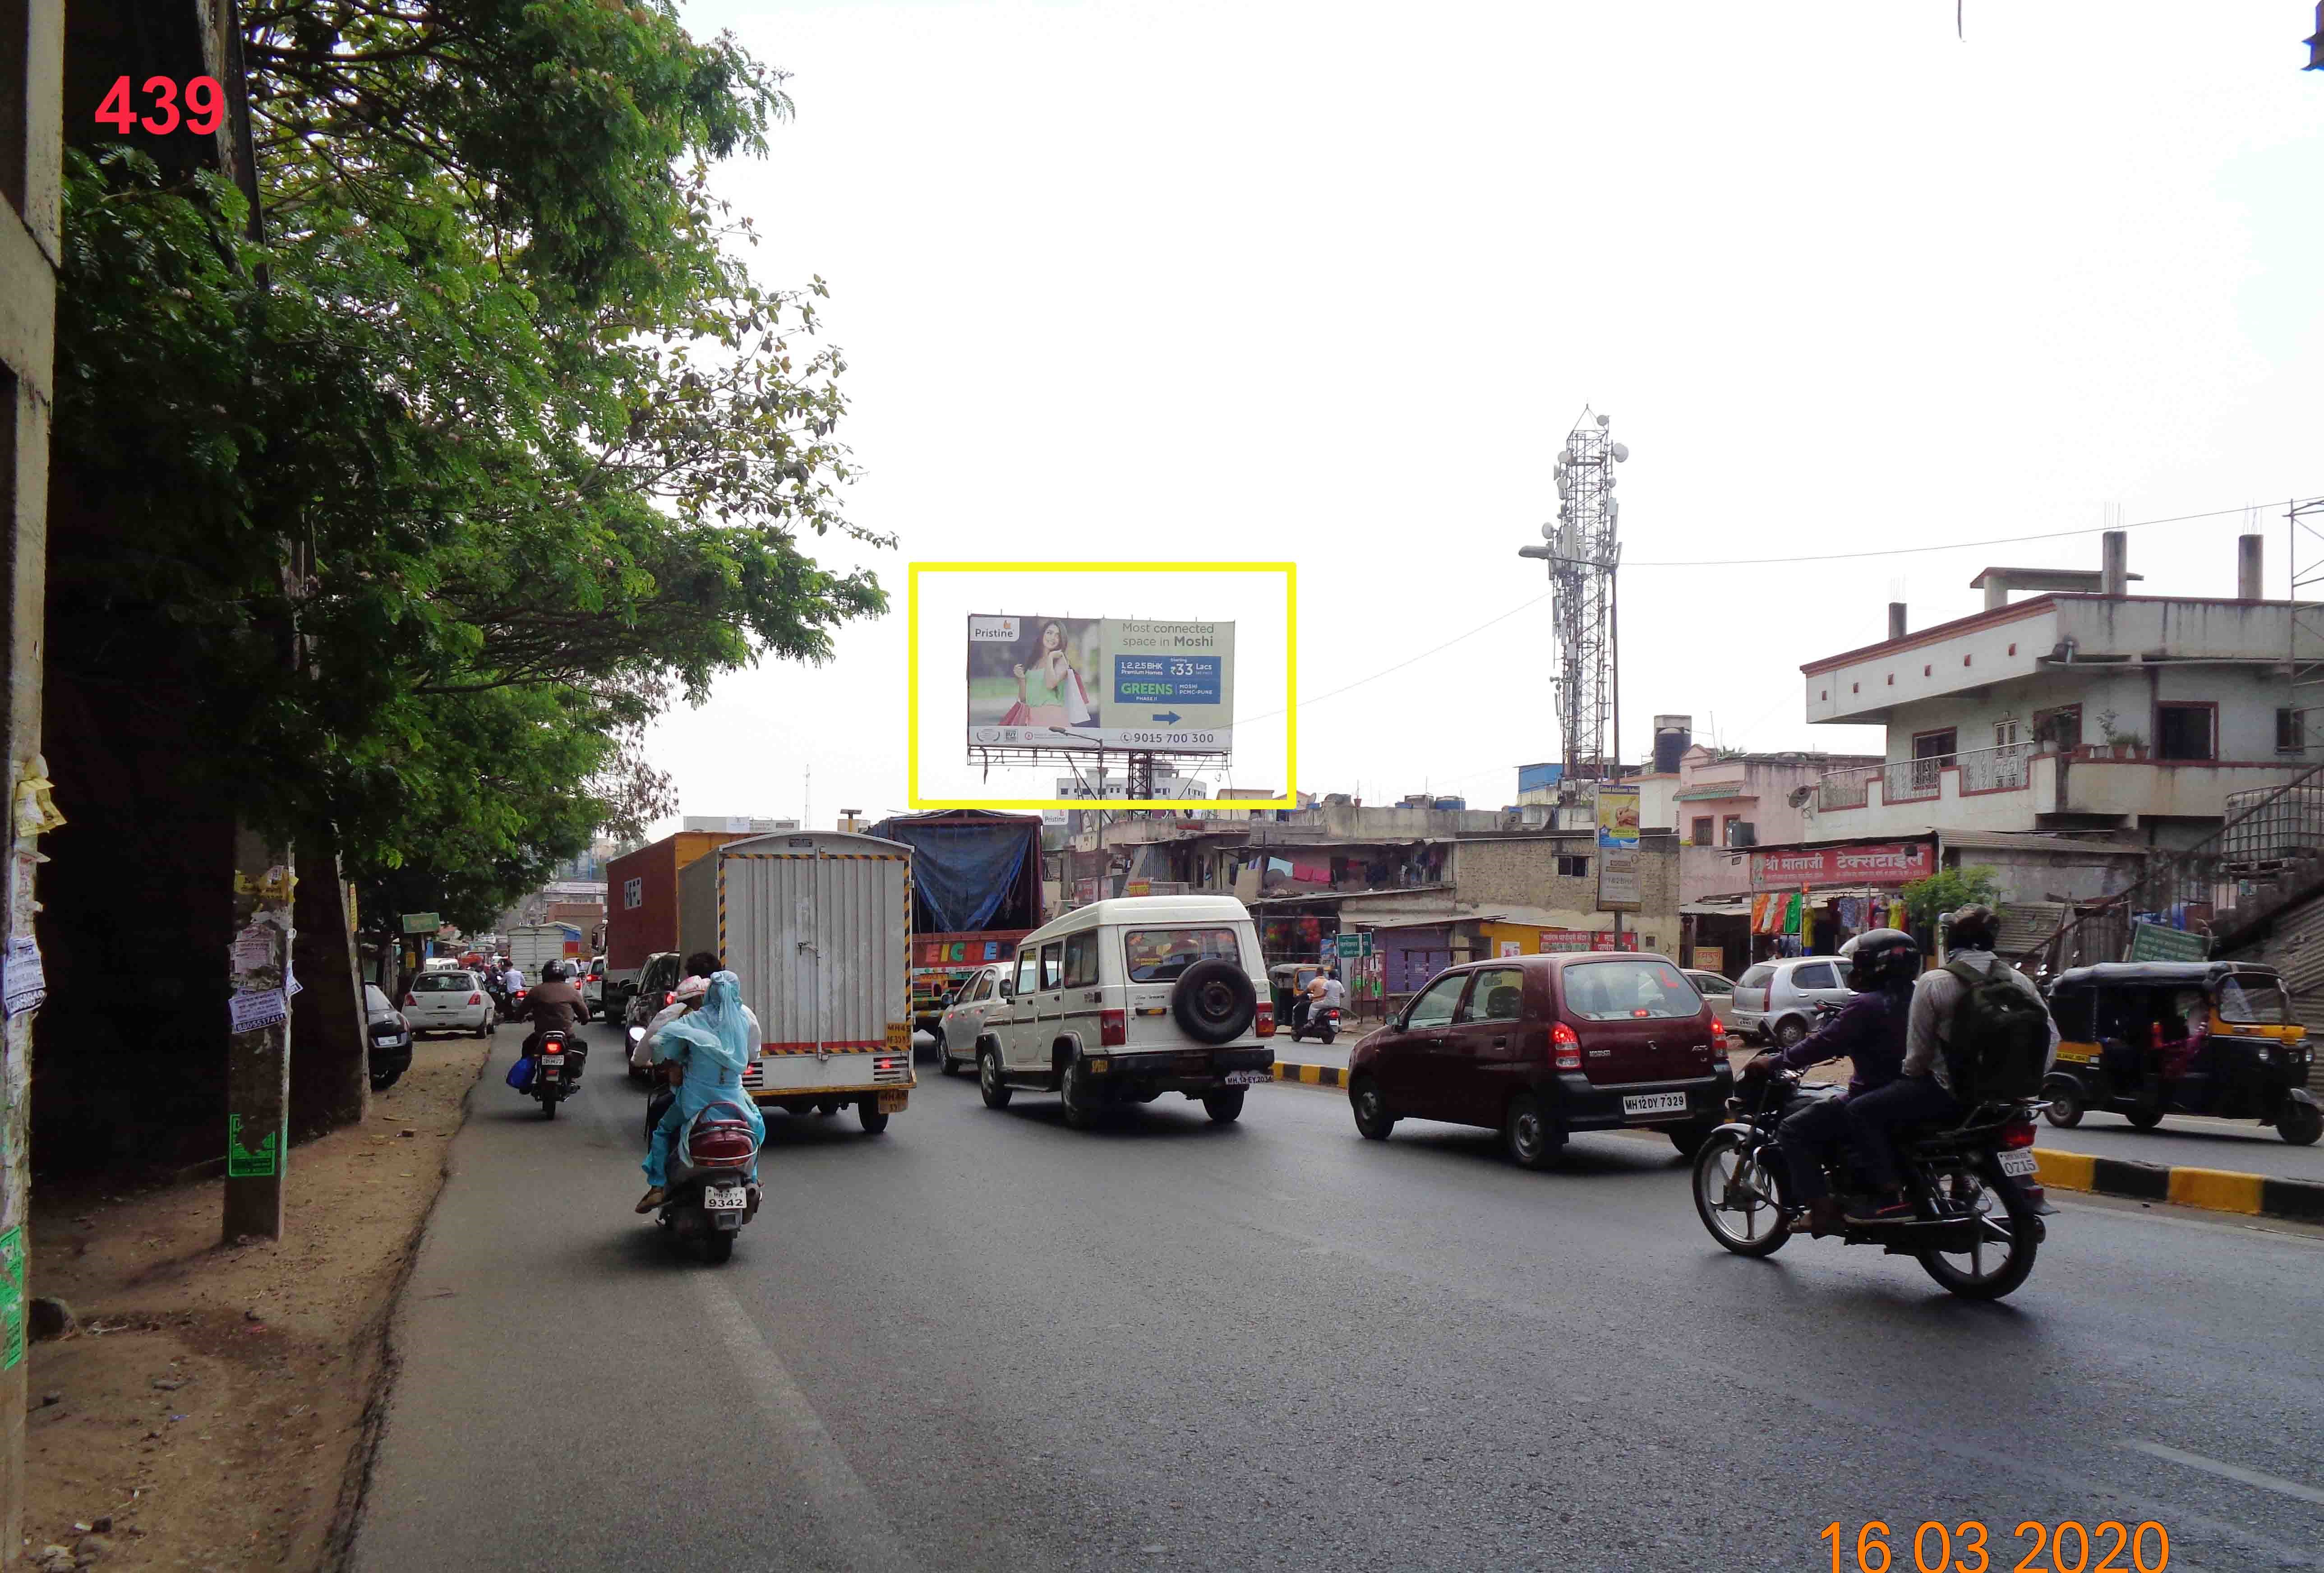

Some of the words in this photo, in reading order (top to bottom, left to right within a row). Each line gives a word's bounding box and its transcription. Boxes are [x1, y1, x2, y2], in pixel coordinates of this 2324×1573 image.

[975, 628, 1013, 637] Pristine
[1122, 623, 1148, 632] Most
[1154, 624, 1214, 633] connected
[1123, 638, 1156, 647] space
[1160, 637, 1169, 646] in
[1174, 636, 1213, 646] Moshi
[1121, 683, 1173, 695] GREENS
[1134, 733, 1162, 743] 9015
[1166, 733, 1188, 743] 700
[1192, 733, 1213, 743] 300
[926, 941, 1014, 962] EICE
[1660, 1096, 1684, 1107] 7329
[2005, 1160, 2036, 1174] 0715
[709, 1199, 743, 1208] 9342
